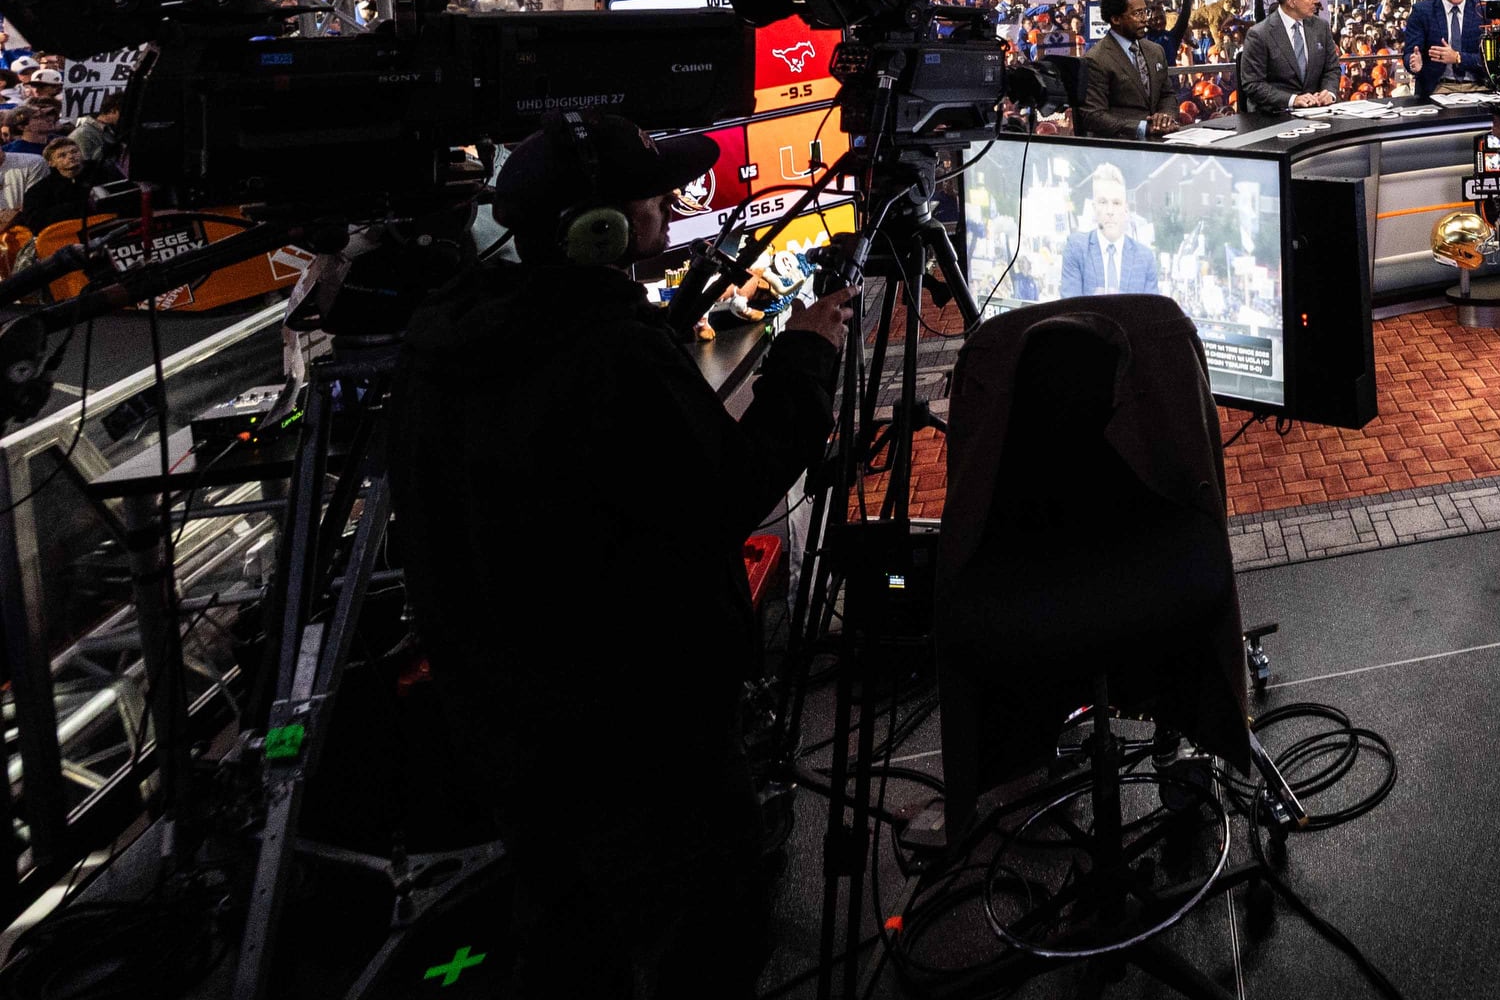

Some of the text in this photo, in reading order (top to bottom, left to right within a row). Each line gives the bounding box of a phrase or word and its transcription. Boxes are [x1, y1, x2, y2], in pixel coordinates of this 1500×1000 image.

[68, 63, 101, 84] On
[671, 62, 713, 73] Canon
[378, 73, 421, 84] SONY
[780, 84, 813, 99] -9.5
[516, 92, 626, 111] UHD DIGISUPER 27
[740, 165, 758, 179] VS
[749, 197, 785, 217] 56.5
